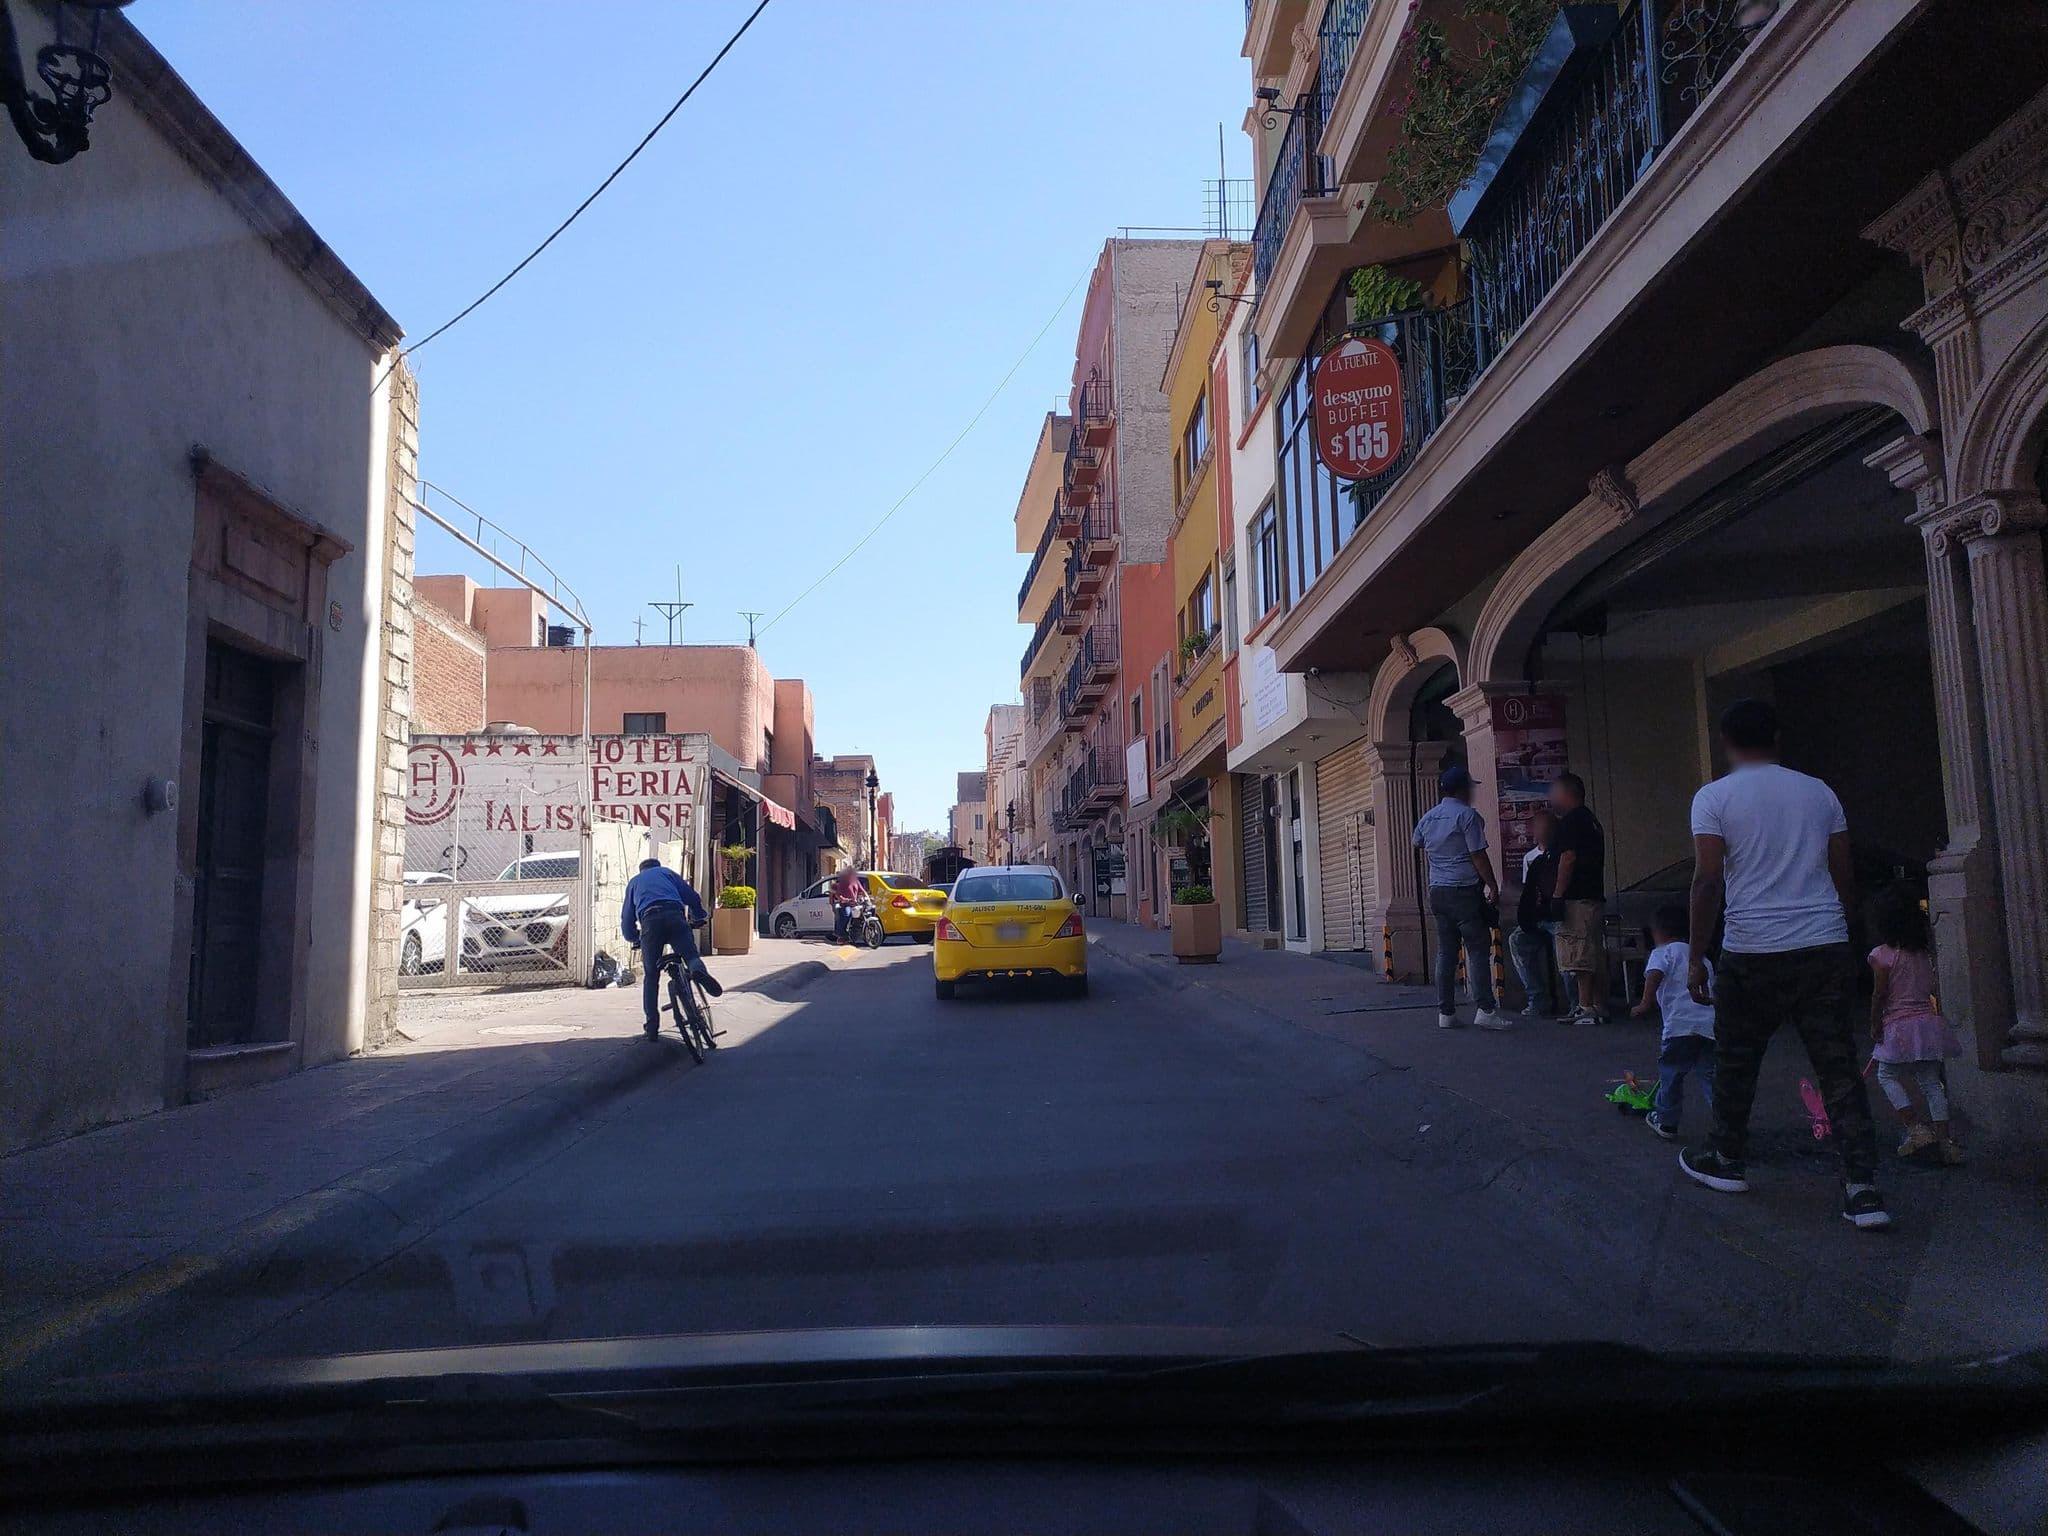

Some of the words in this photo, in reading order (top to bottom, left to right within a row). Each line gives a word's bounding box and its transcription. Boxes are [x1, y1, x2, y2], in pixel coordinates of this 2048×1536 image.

[1329, 357, 1342, 373] LA
[1344, 352, 1381, 370] FUENTE
[1322, 384, 1393, 407] desayuno
[1328, 400, 1389, 425] BUFFET
[590, 737, 695, 764] HOTEL
[971, 905, 996, 913] JALISCO
